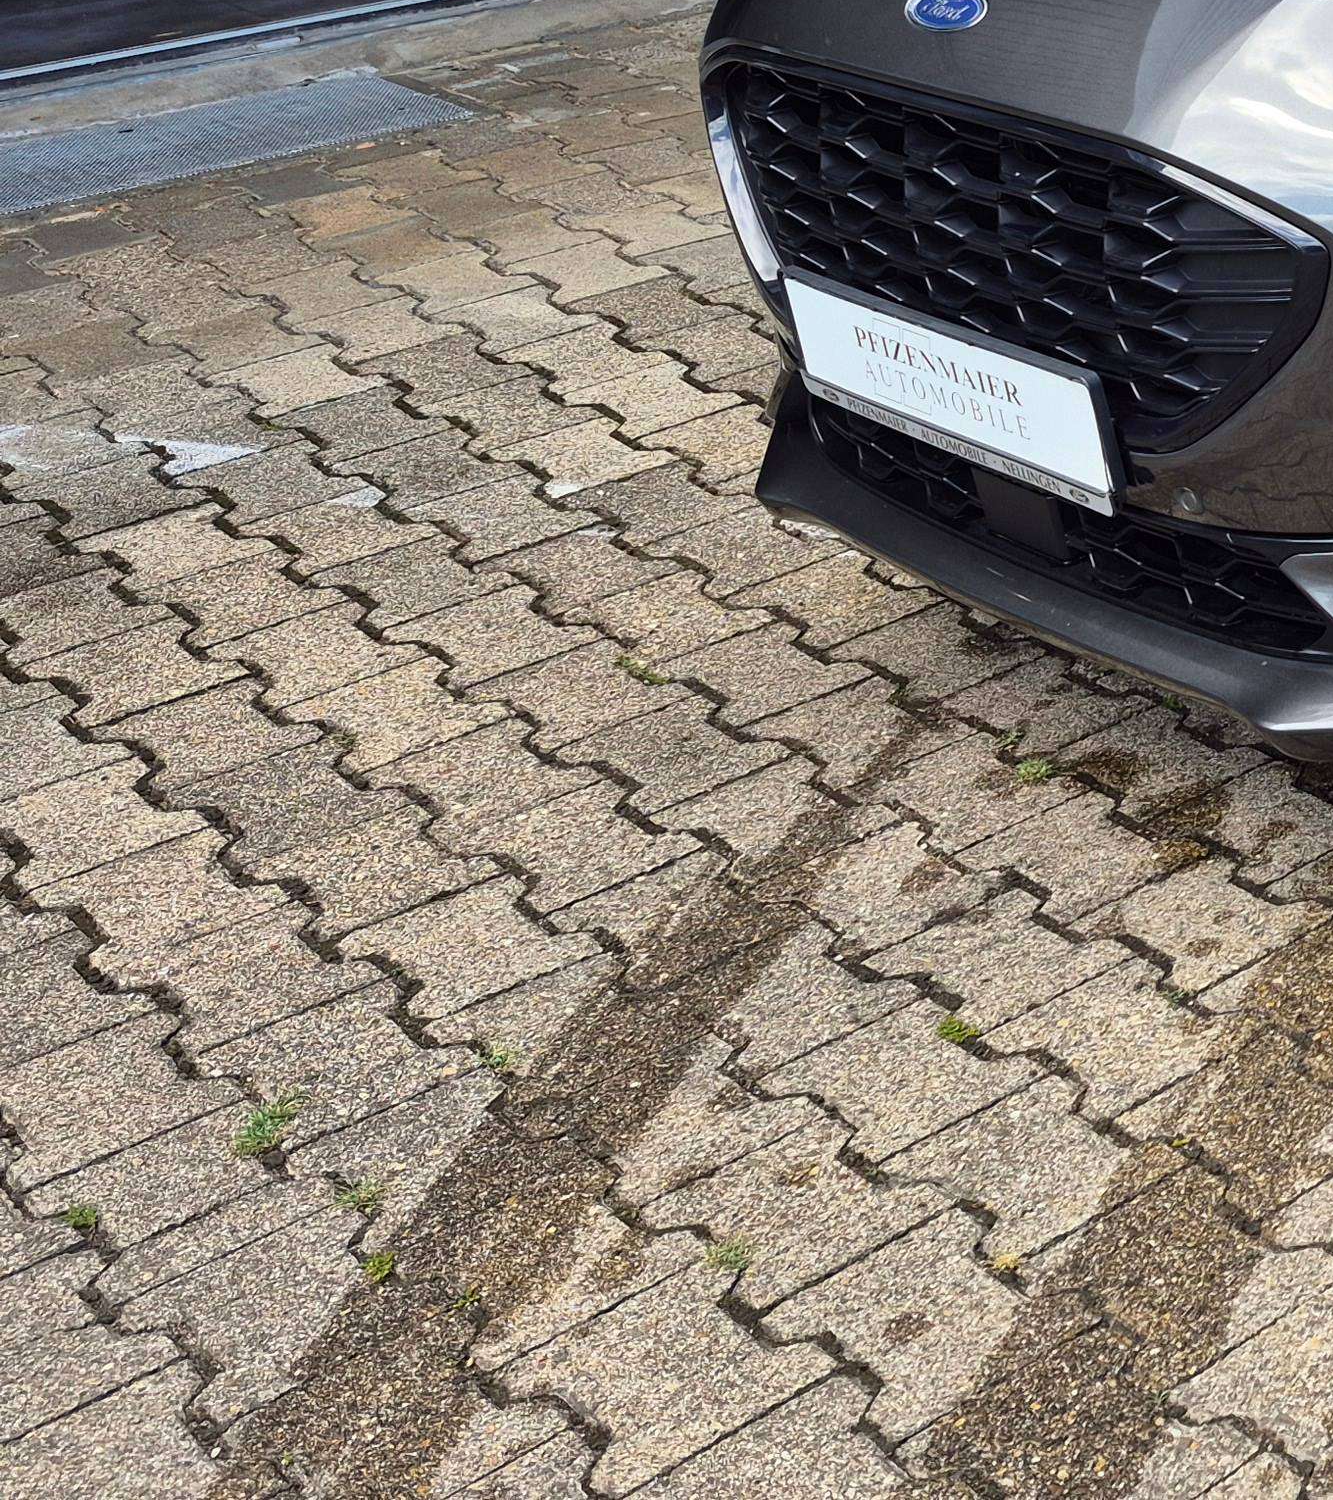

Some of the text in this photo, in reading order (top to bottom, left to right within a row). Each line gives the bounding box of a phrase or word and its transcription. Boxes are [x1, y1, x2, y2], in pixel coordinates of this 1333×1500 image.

[853, 325, 1023, 406] PFIZENMAIER
[863, 359, 1032, 441] AUTOMOBILE
[846, 398, 1062, 493] PFIZENMAIER AUTOMOBILE NELLINGEN
